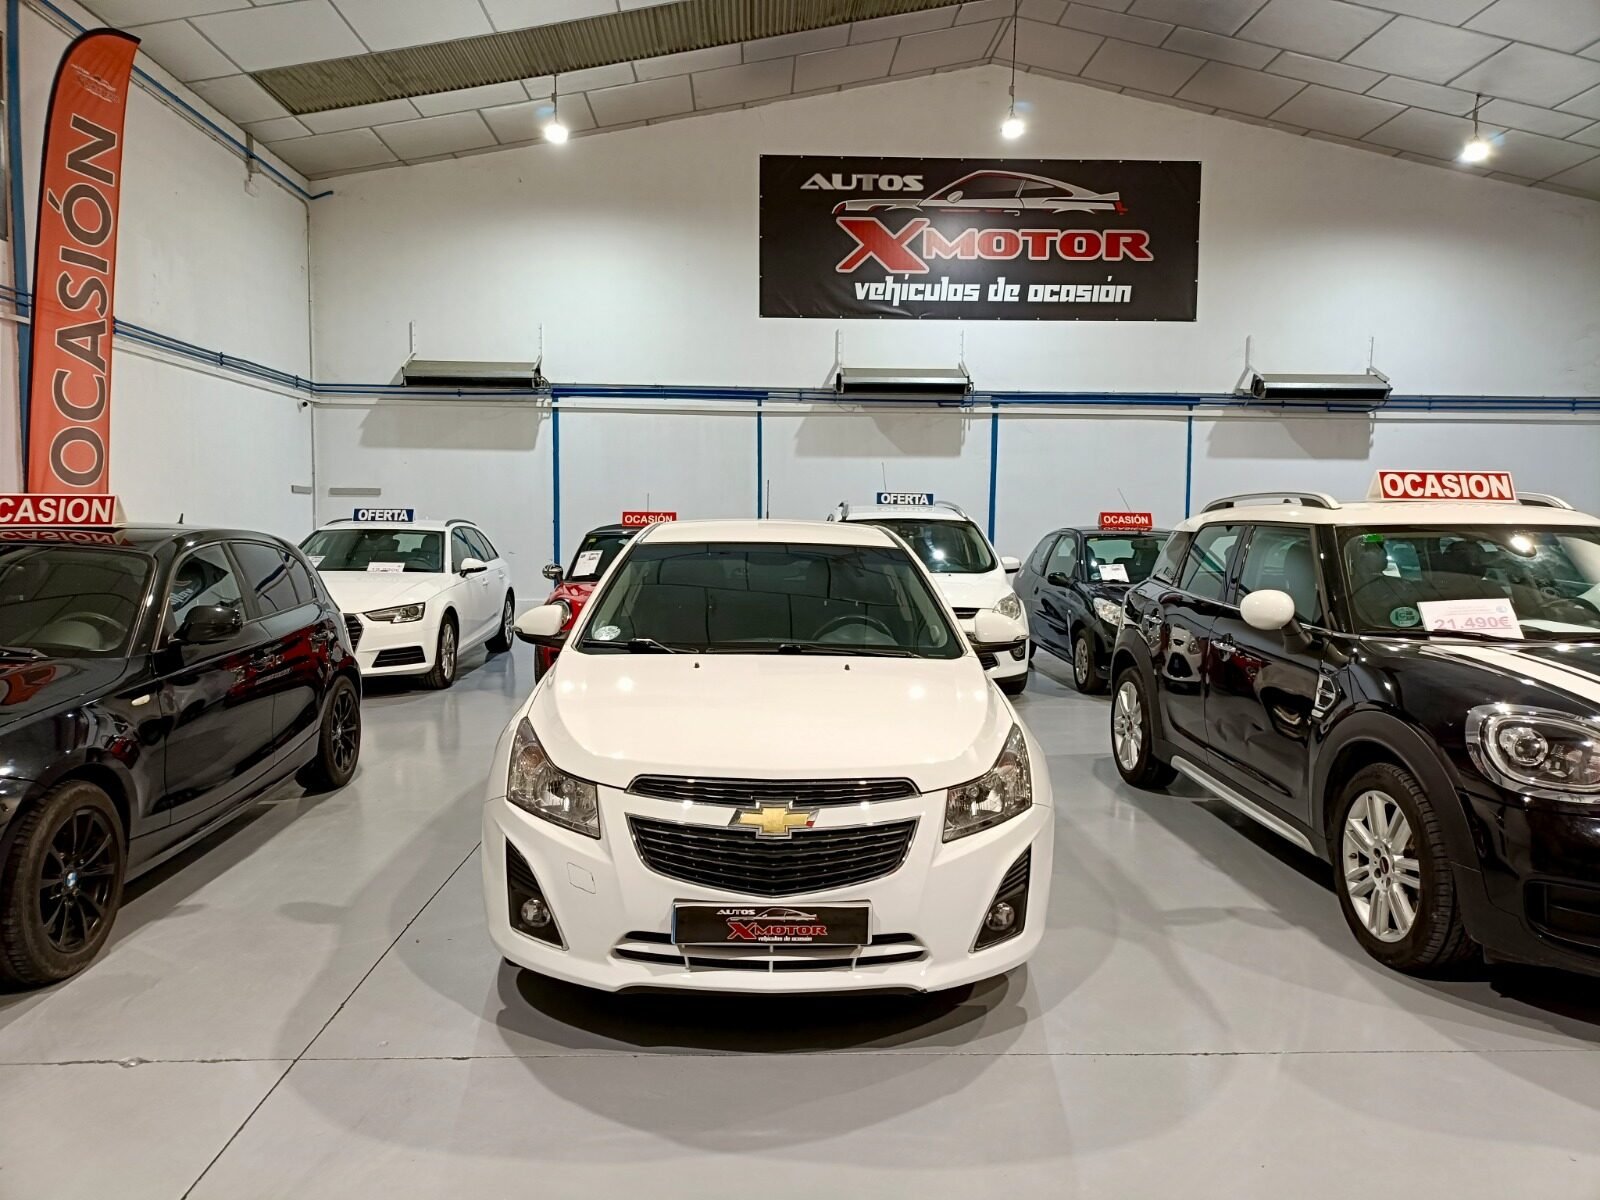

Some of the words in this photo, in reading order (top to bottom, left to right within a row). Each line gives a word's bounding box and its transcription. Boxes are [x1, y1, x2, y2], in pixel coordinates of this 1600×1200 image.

[800, 173, 924, 192] AUTOS
[854, 274, 980, 306] vehículos
[988, 276, 1020, 302] de
[1027, 275, 1133, 303] ocasión
[47, 113, 117, 487] OCASIÓN
[1382, 473, 1513, 499] OCASION
[881, 493, 929, 505] OFERTA
[358, 509, 408, 521] OFERTA
[1103, 514, 1149, 524] OCASIÓN
[716, 908, 756, 916] AUTOS
